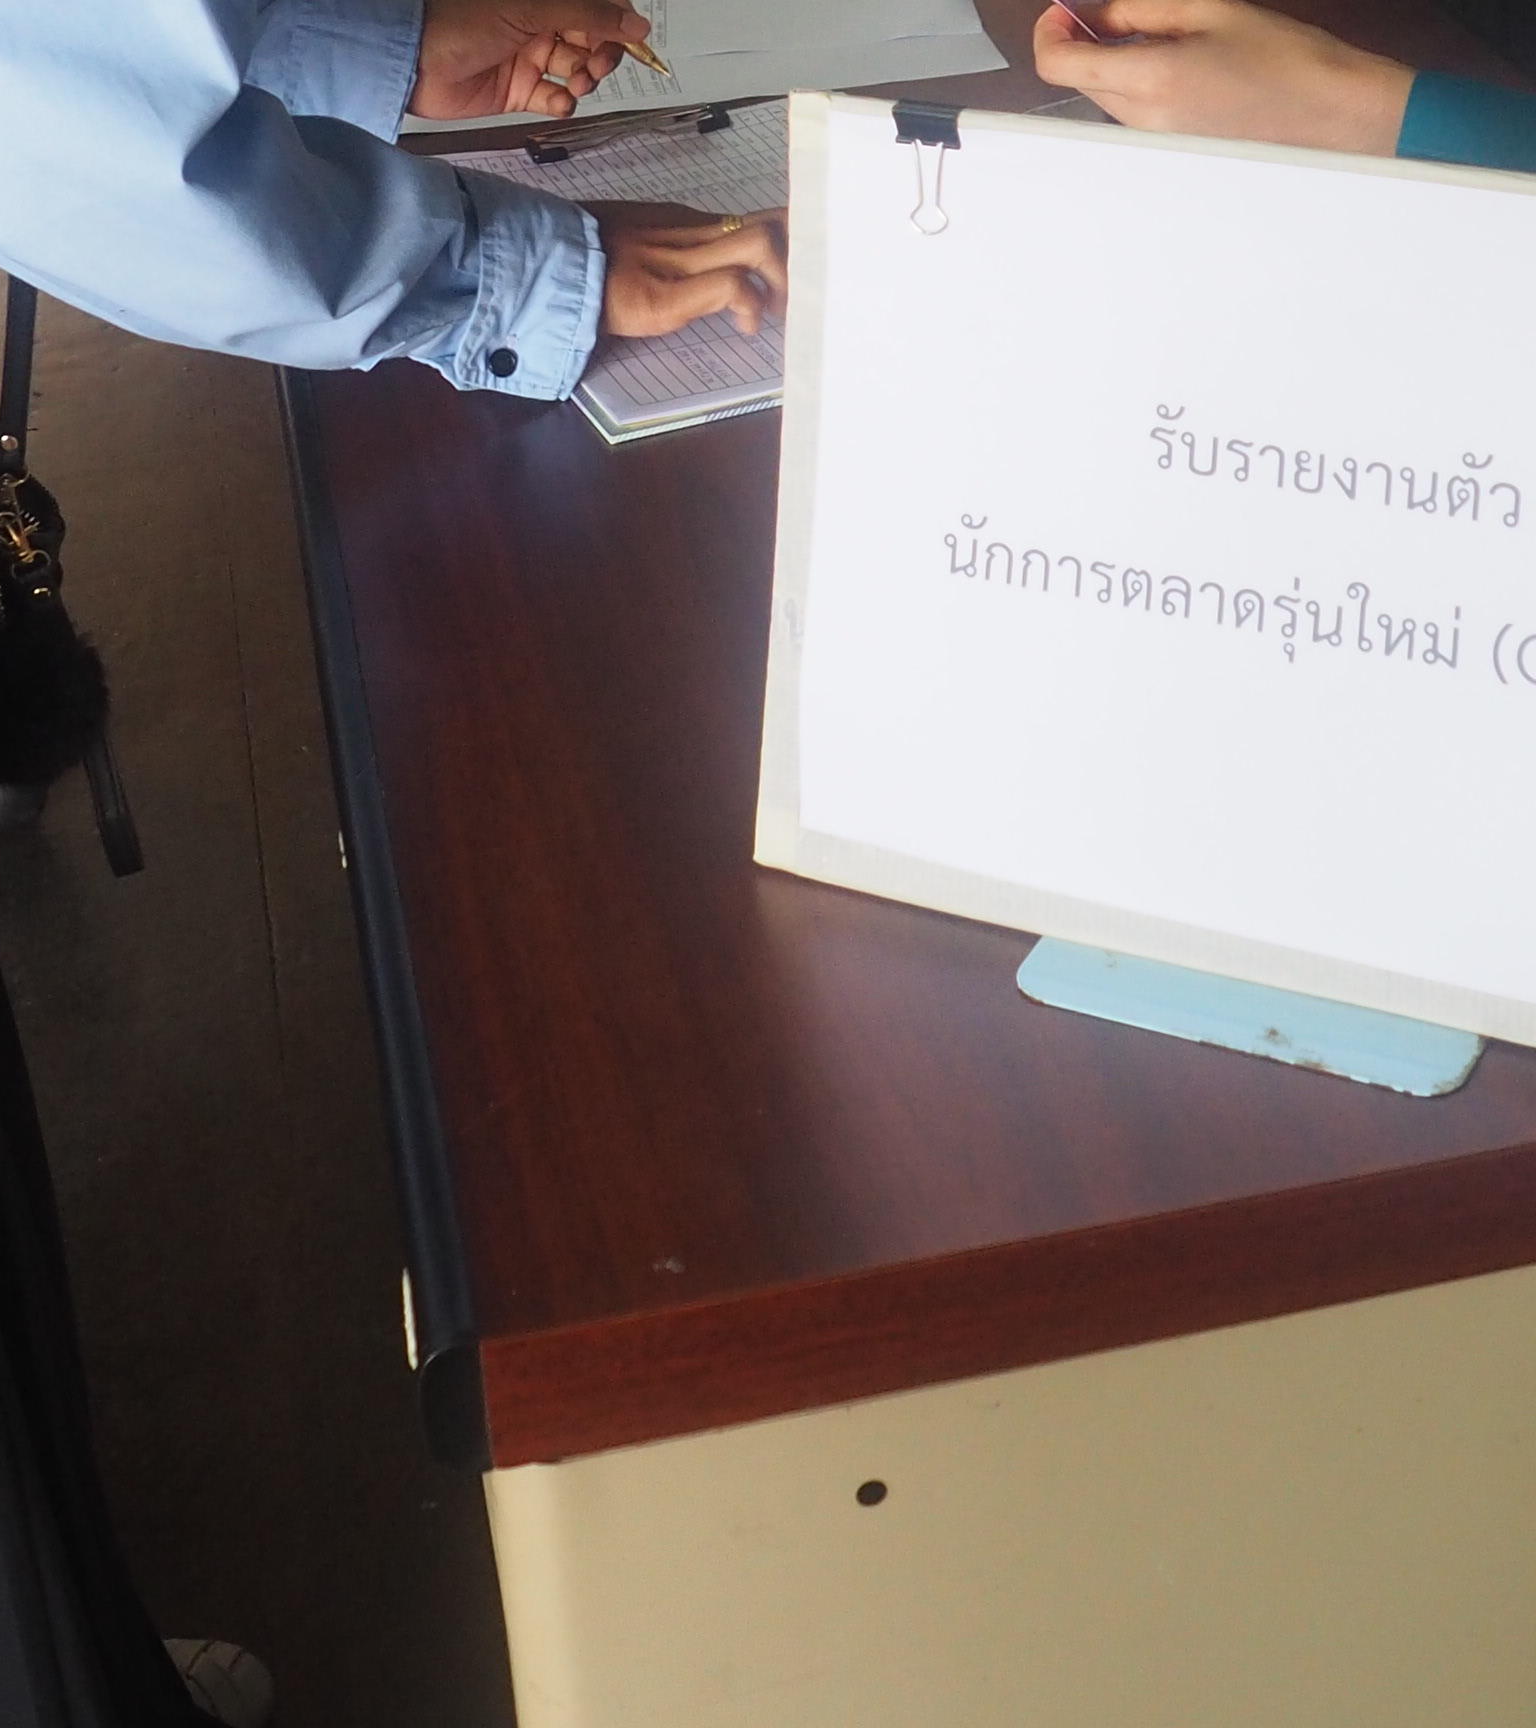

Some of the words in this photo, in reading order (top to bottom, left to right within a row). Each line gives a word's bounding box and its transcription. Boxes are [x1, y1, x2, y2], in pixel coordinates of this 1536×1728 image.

[1149, 403, 1524, 530] รับรายงานตัว
[942, 512, 1463, 670] นักการตลาดรุ่นใหม่
